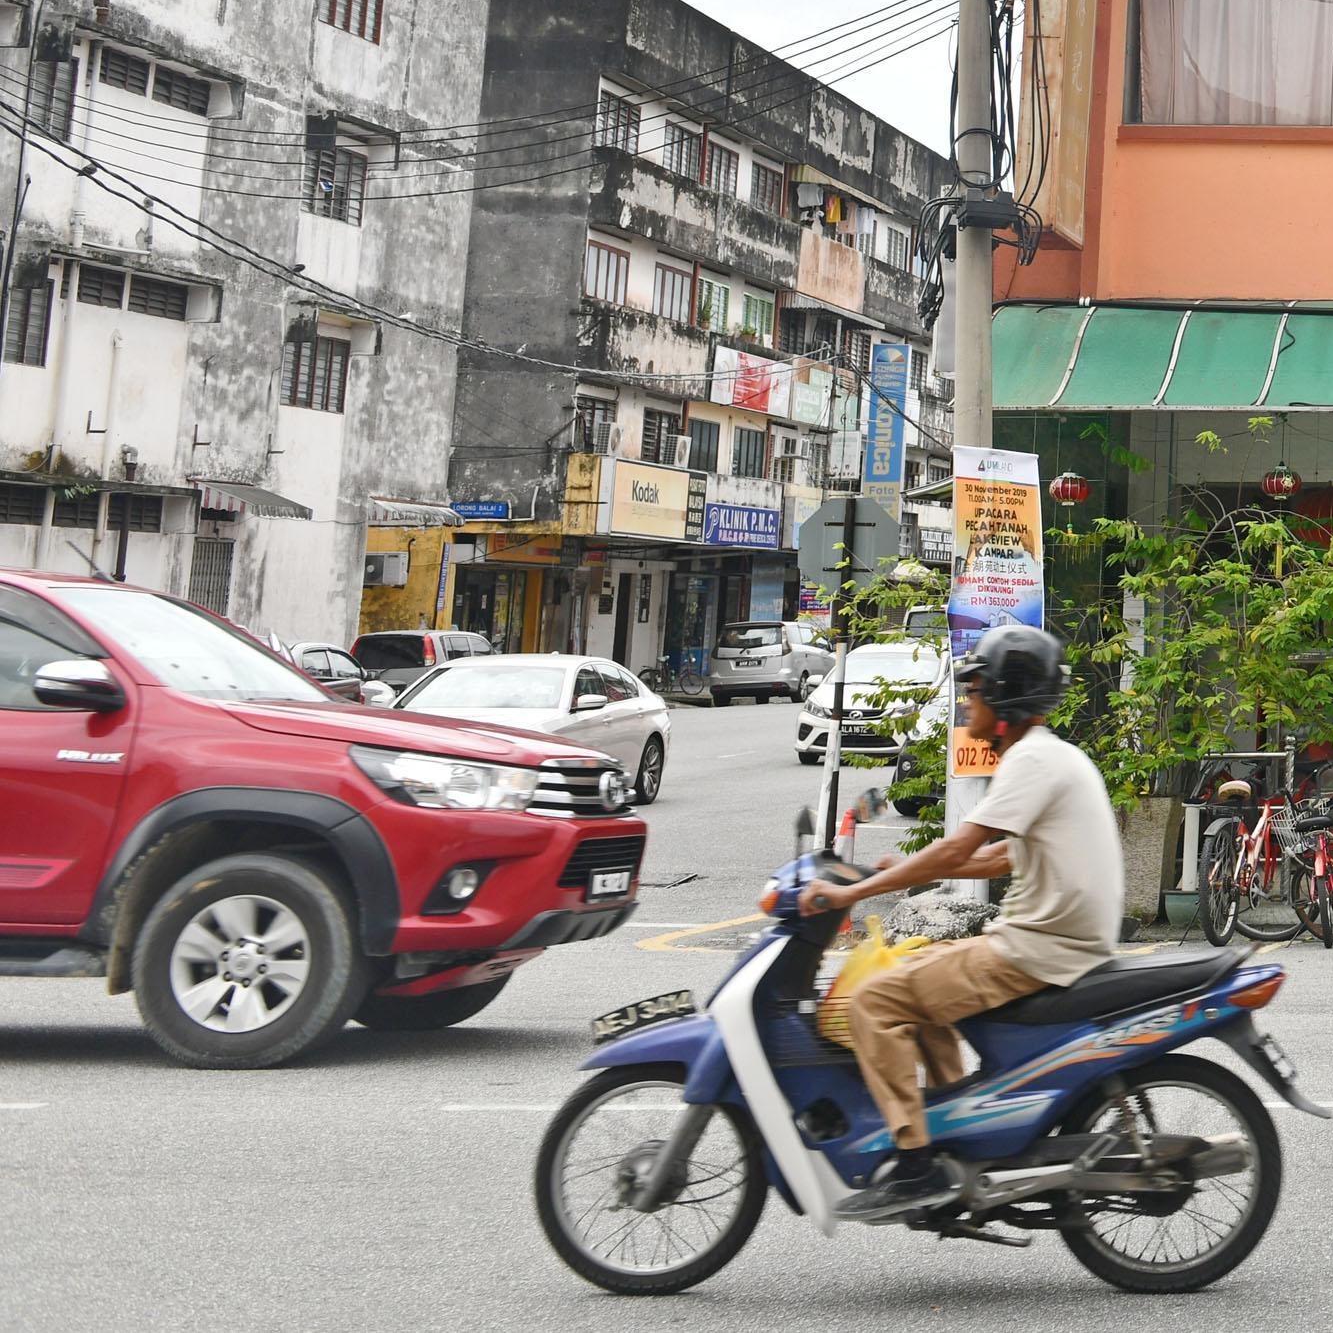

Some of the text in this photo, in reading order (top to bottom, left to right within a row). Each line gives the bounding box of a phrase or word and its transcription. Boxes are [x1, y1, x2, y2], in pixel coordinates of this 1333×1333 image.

[873, 398, 897, 475] Konica
[632, 480, 660, 504] Kodak
[869, 486, 895, 495] Foto
[965, 484, 973, 492] 30
[974, 485, 1011, 495] November
[453, 504, 477, 512] LORONG
[974, 508, 1018, 521] UPACARA
[719, 508, 776, 534] KLINIK P.M.C.
[965, 520, 1028, 534] PECAH TANAH
[969, 534, 1022, 546] LAKEVIEW
[975, 547, 1014, 559] KAMPAR
[956, 747, 976, 767] 012
